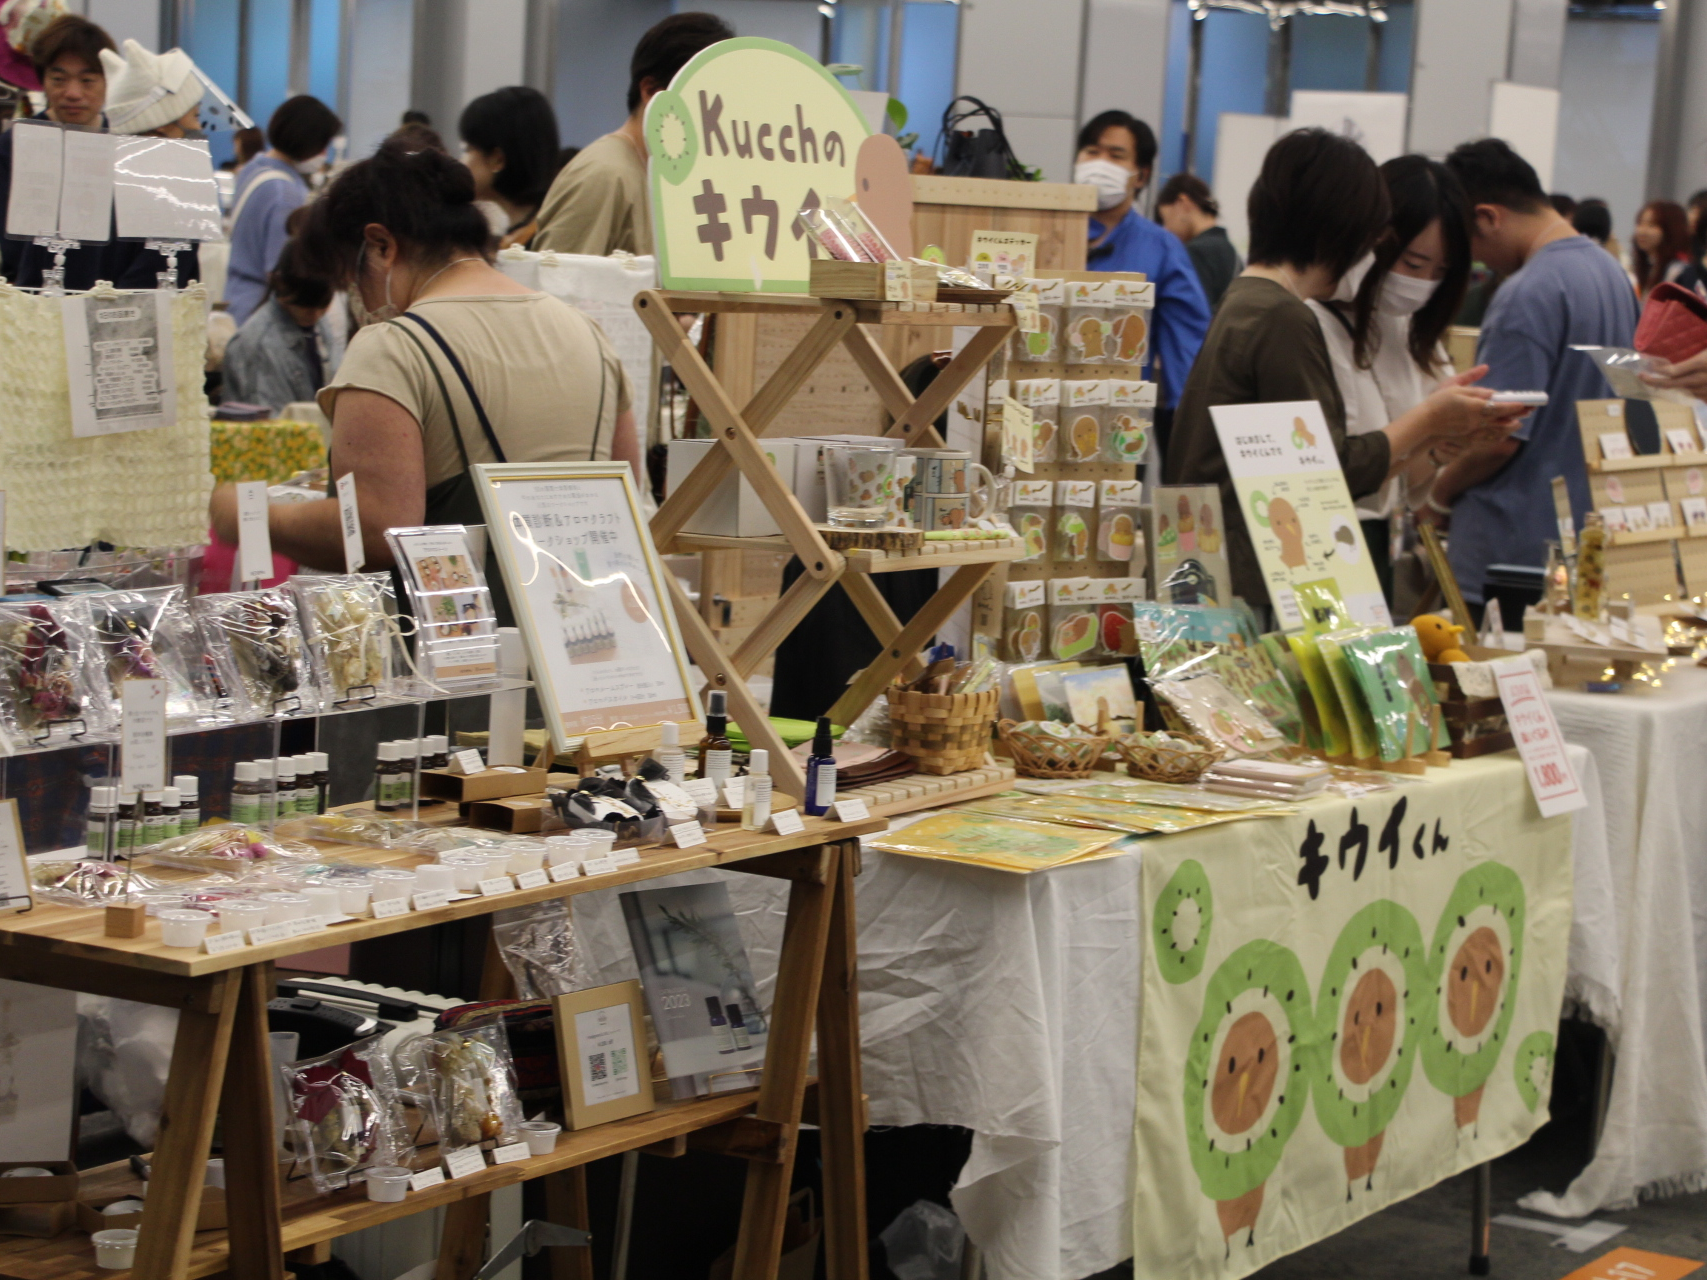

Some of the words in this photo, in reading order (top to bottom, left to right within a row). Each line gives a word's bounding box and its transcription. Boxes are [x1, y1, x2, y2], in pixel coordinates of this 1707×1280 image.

[698, 90, 845, 168] Kucchの
[1297, 795, 1449, 900] キウイくん
[661, 993, 692, 1010] 2023
